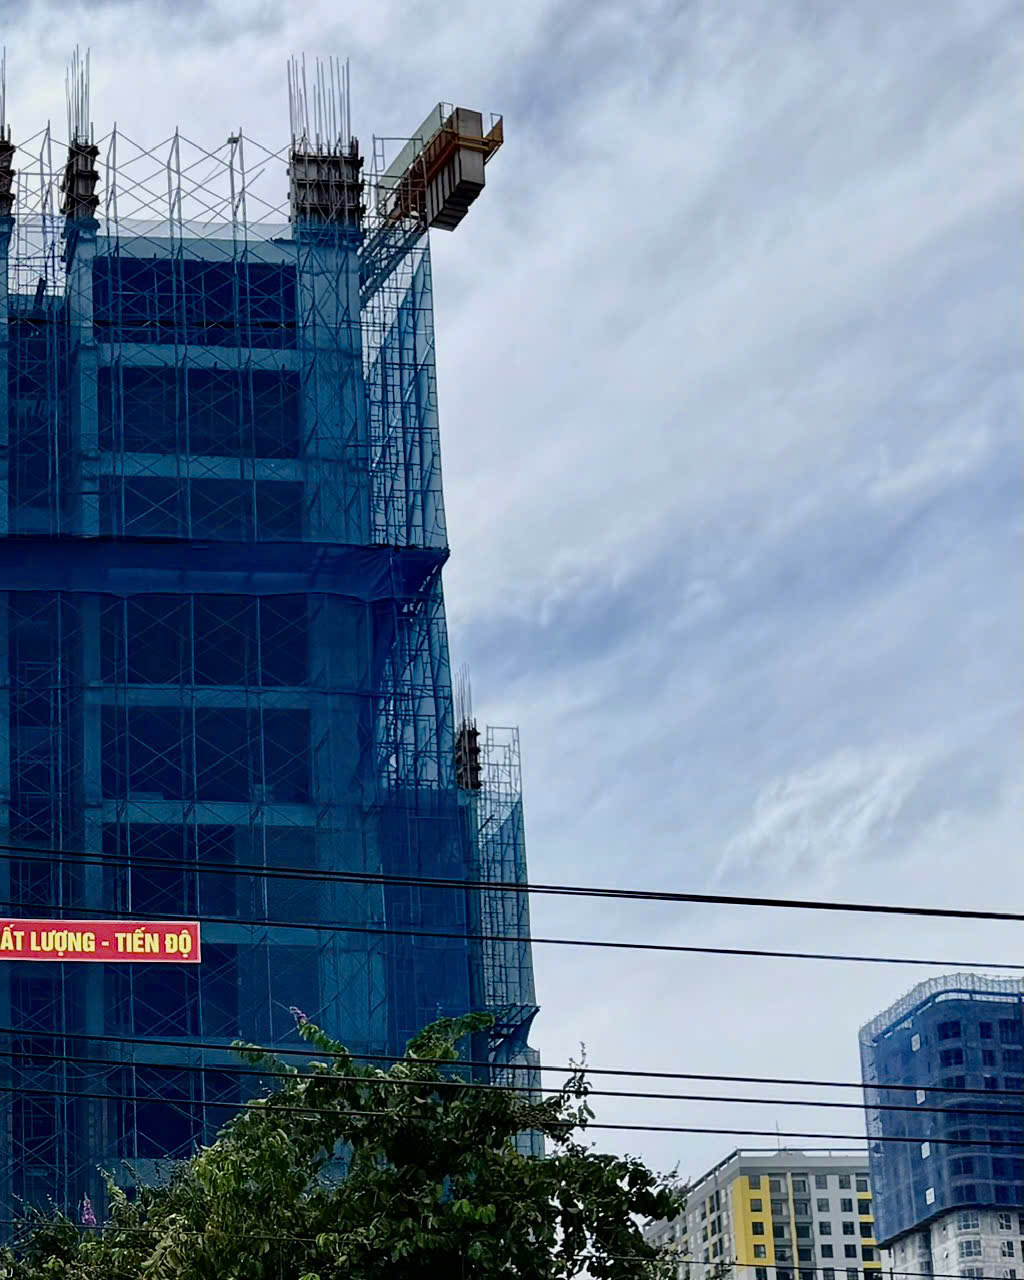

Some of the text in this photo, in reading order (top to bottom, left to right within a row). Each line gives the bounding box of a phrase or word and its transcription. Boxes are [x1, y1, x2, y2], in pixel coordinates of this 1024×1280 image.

[30, 929, 96, 956] LƯỢNG
[115, 926, 159, 953] TIẾN
[165, 929, 192, 958] ĐỘ
